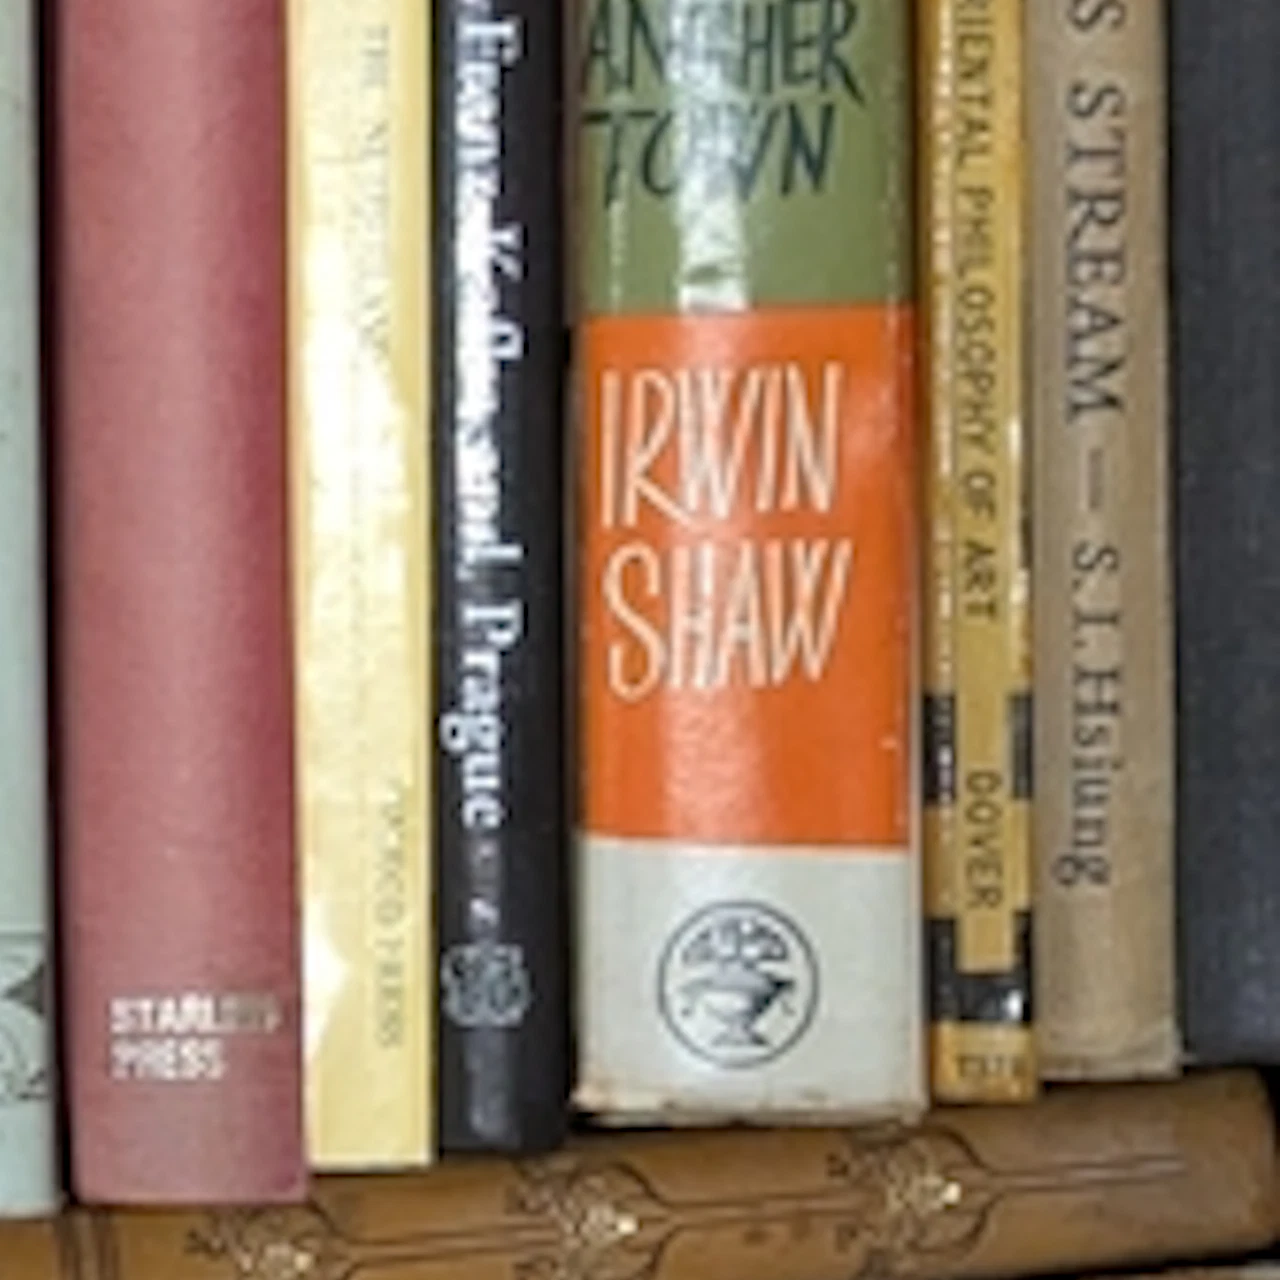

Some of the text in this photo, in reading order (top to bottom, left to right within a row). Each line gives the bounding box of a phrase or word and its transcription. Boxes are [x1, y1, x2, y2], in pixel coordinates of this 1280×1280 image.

[957, 183, 998, 451] PHILOSOPHY
[1065, 82, 1128, 425] STREAM
[597, 361, 843, 530] IRWIN
[959, 465, 998, 526] OF
[602, 538, 854, 703] SHAW
[959, 542, 1000, 620] ART
[438, 602, 524, 831] Prague
[966, 771, 1005, 913] DOVER
